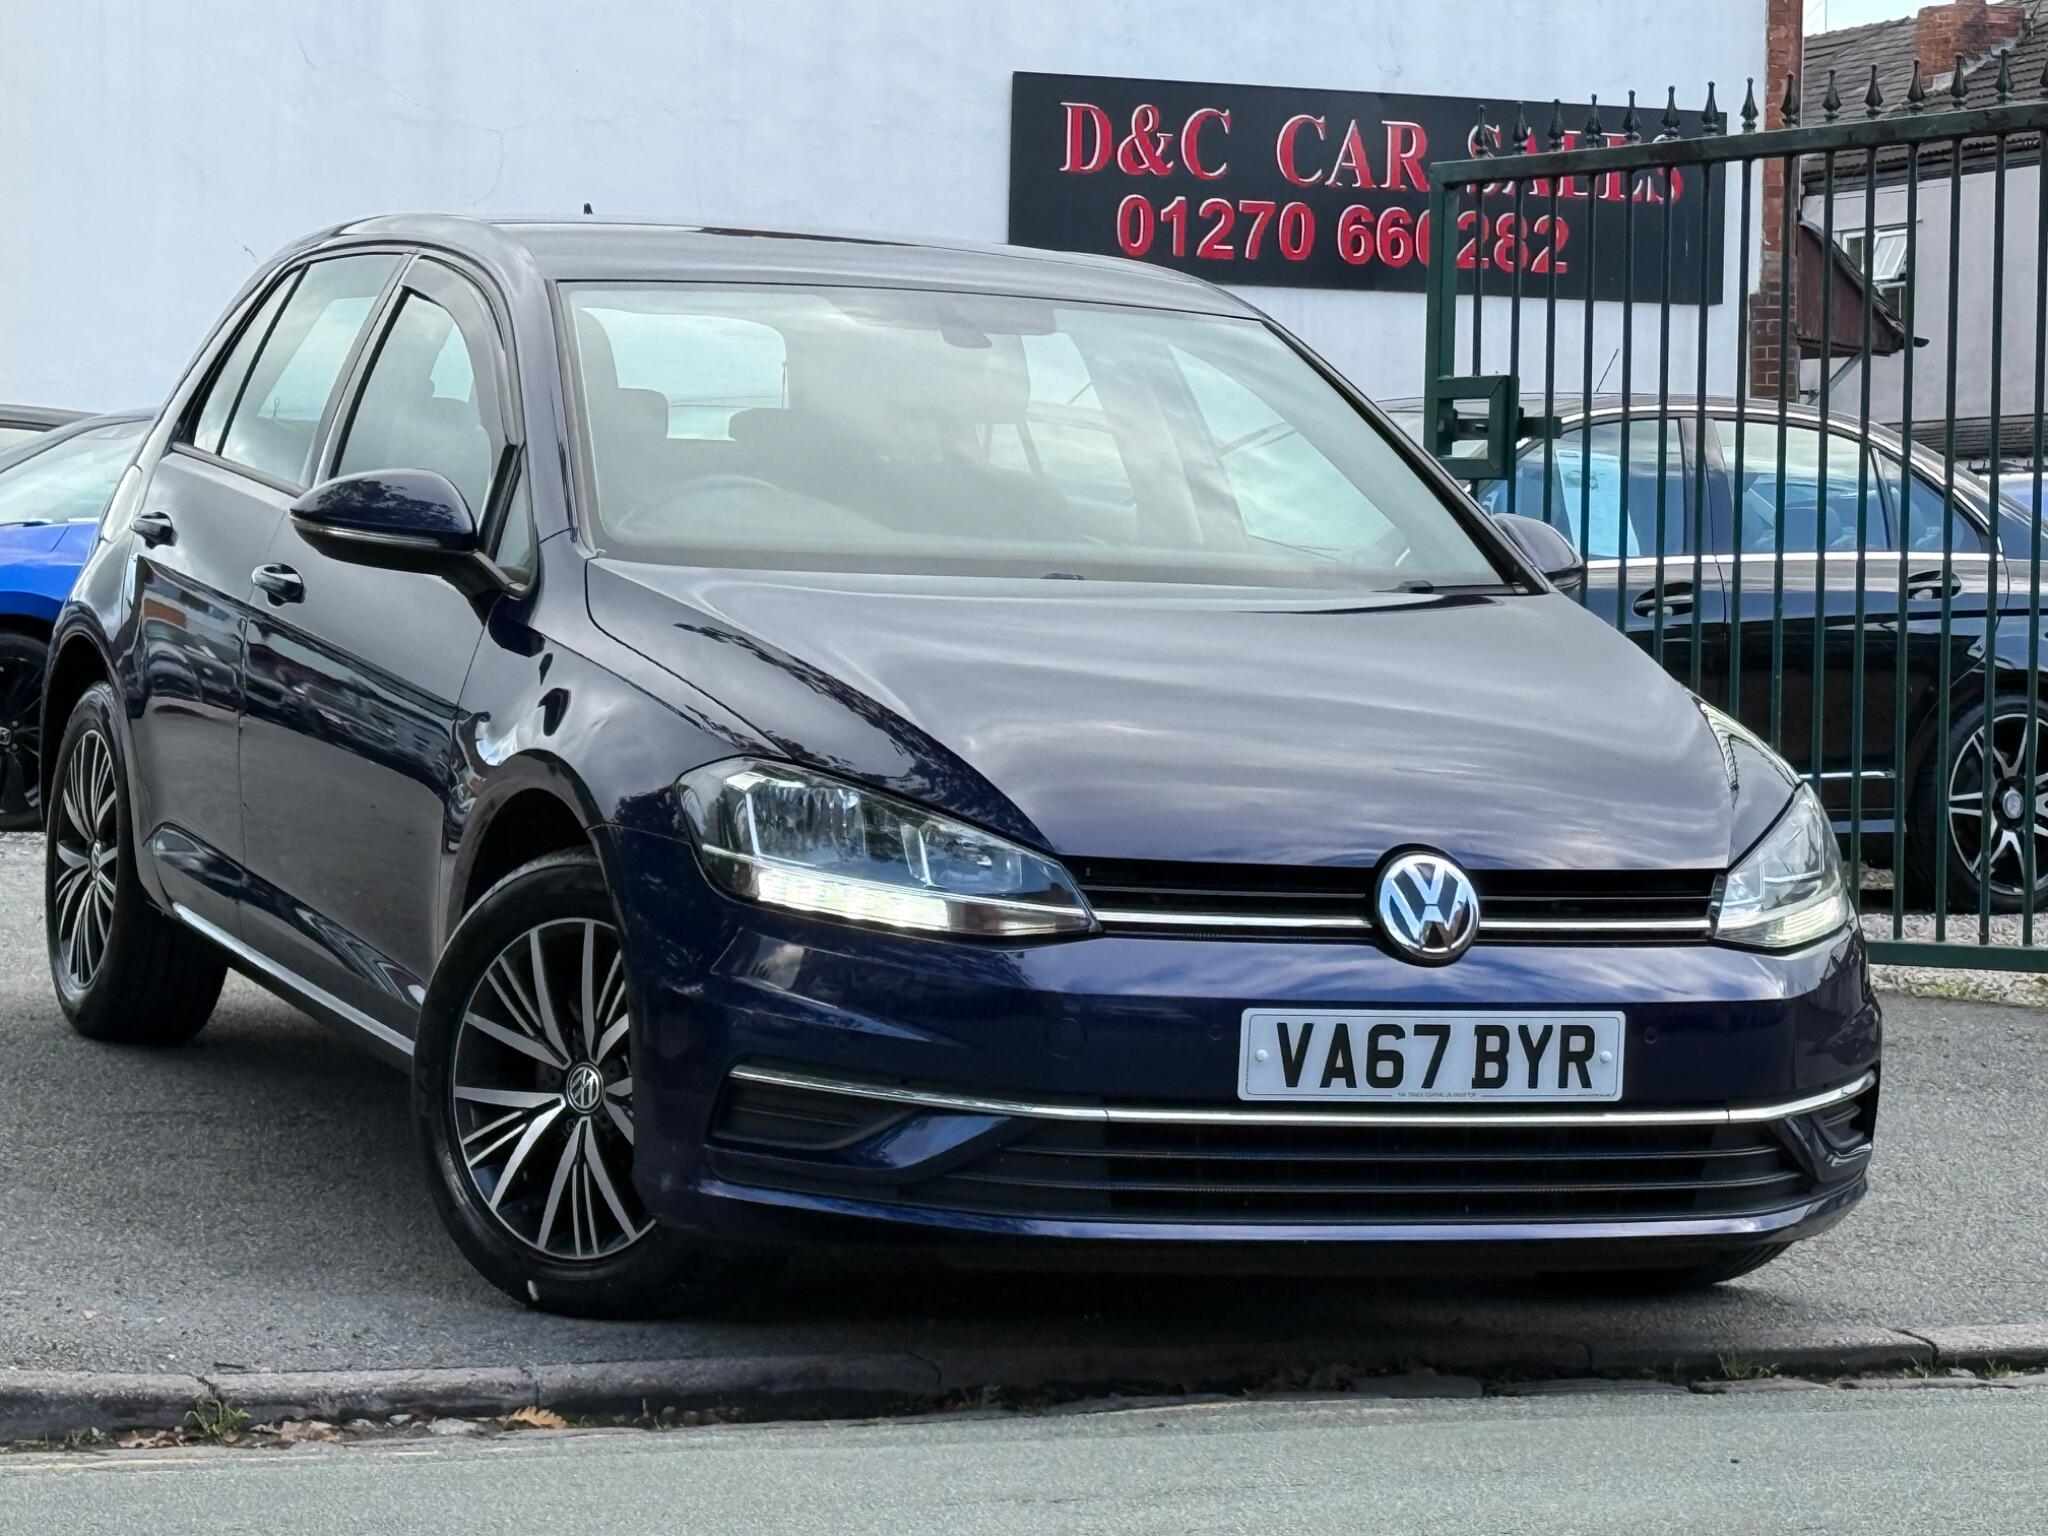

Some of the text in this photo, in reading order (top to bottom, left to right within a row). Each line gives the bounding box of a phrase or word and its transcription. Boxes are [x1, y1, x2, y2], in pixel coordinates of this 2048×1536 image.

[1058, 101, 1232, 181] D&C
[1275, 113, 1430, 192] CAR
[1116, 193, 1316, 261] 01270
[1276, 1021, 1596, 1090] VA67 BYR
